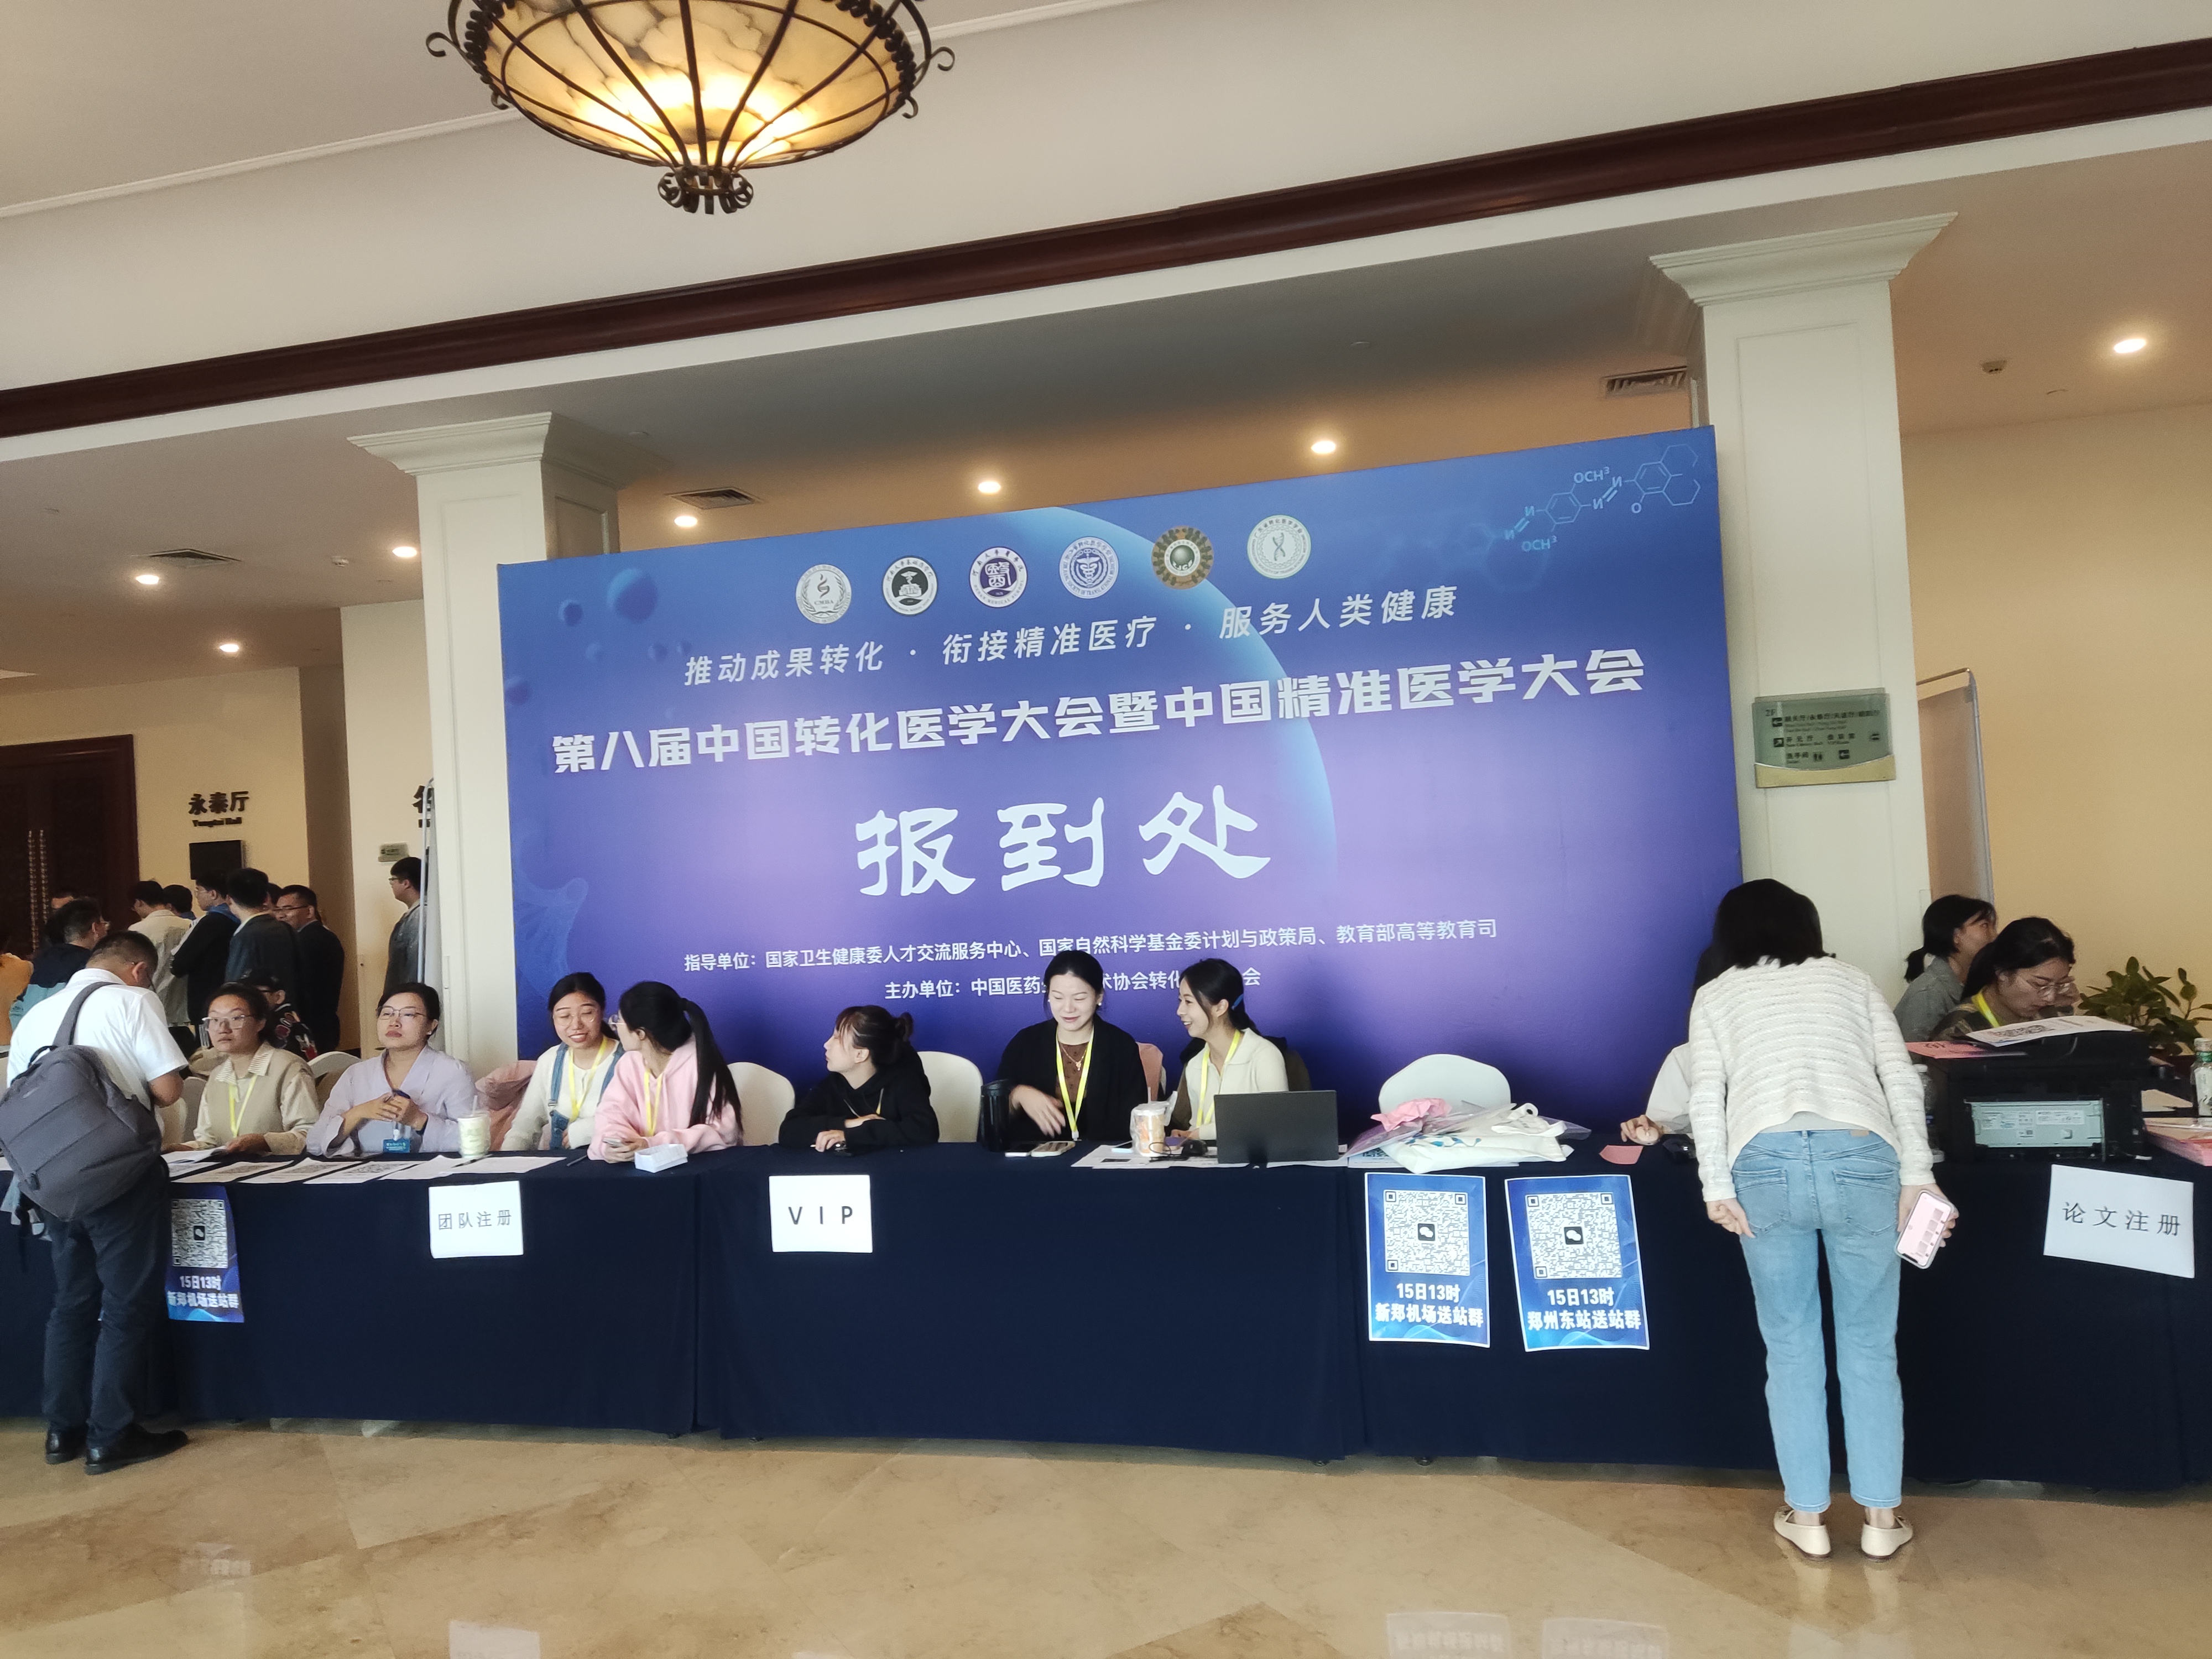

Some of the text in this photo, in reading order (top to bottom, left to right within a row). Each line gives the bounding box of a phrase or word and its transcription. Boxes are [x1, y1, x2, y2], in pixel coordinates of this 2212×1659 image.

[685, 585, 1458, 686] 推动成果转化 衔接精准医疗 服务人类健康
[552, 649, 1644, 773] 第八届中国转化医学大会暨中国精准医学大会
[188, 791, 249, 815] 永泰厅
[855, 785, 1271, 896] 报到处
[438, 1209, 512, 1230] 团队注册
[2063, 1202, 2180, 1237] 论文注册
[179, 1275, 222, 1291] 15日13时
[1396, 1283, 1460, 1302] 15日13时
[1547, 1286, 1615, 1306] 15日13时
[1375, 1302, 1484, 1328] 新郑机场送站群
[1527, 1309, 1642, 1331] 郑州东站送站群
